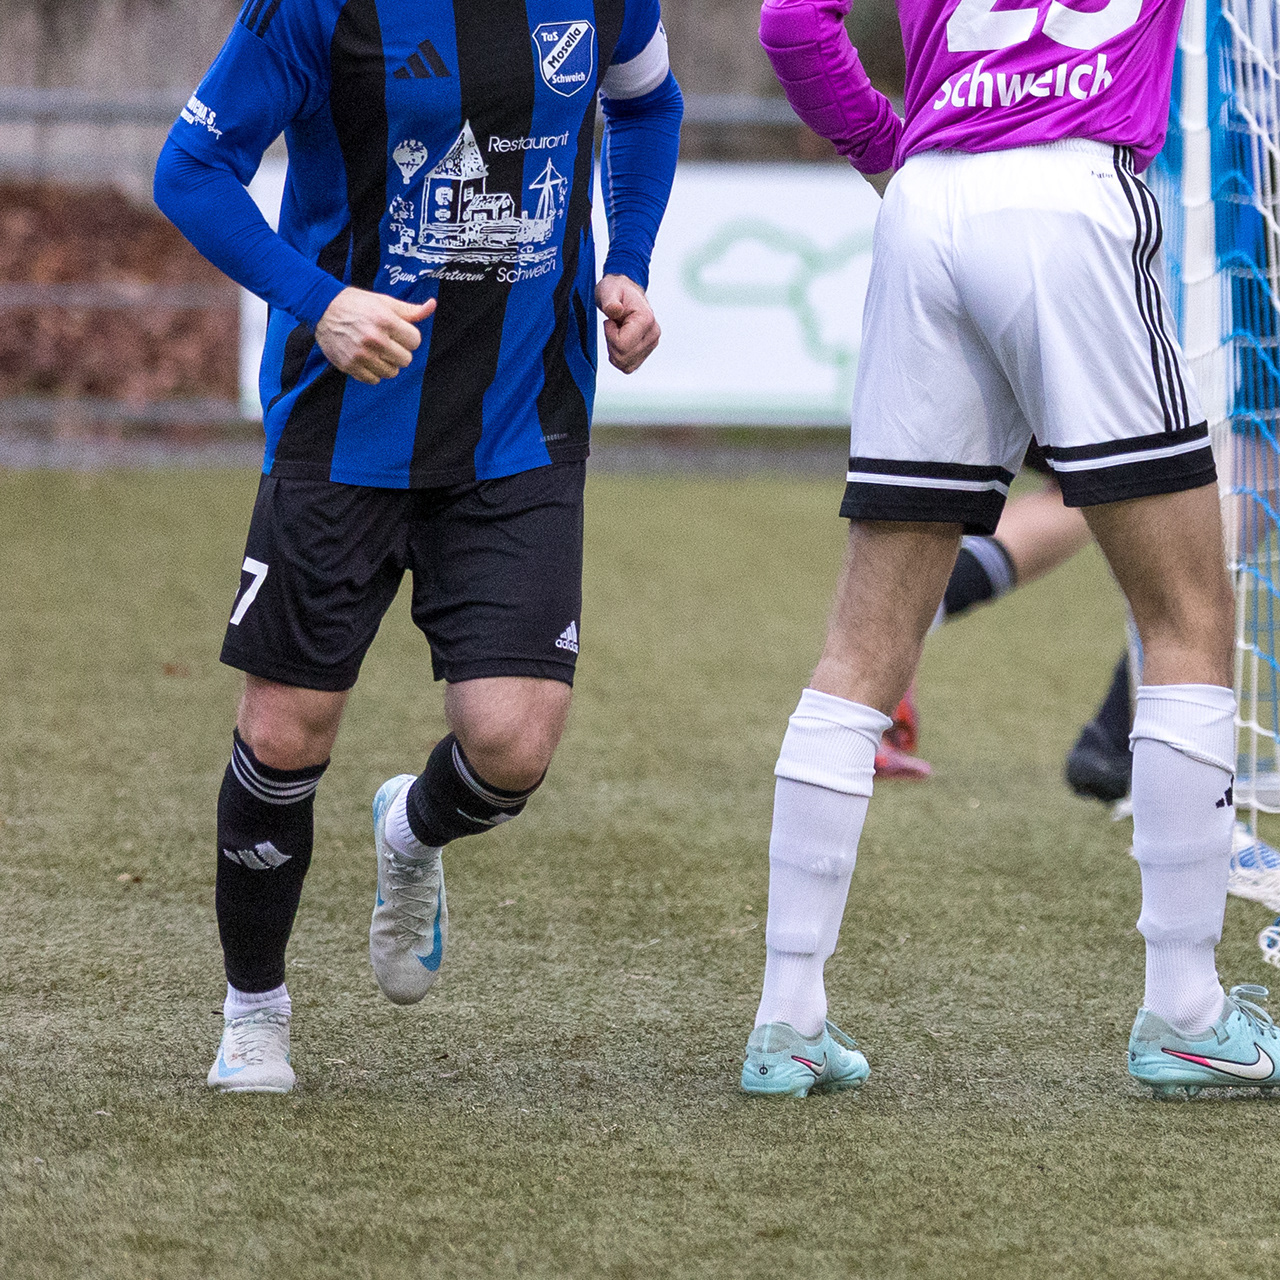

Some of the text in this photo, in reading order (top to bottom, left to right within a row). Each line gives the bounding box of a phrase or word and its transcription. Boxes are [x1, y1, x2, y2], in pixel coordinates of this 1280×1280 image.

[547, 27, 582, 70] Mosella
[551, 71, 587, 84] Schweich
[488, 130, 570, 153] Restaurant
[496, 257, 557, 284] Schweich
